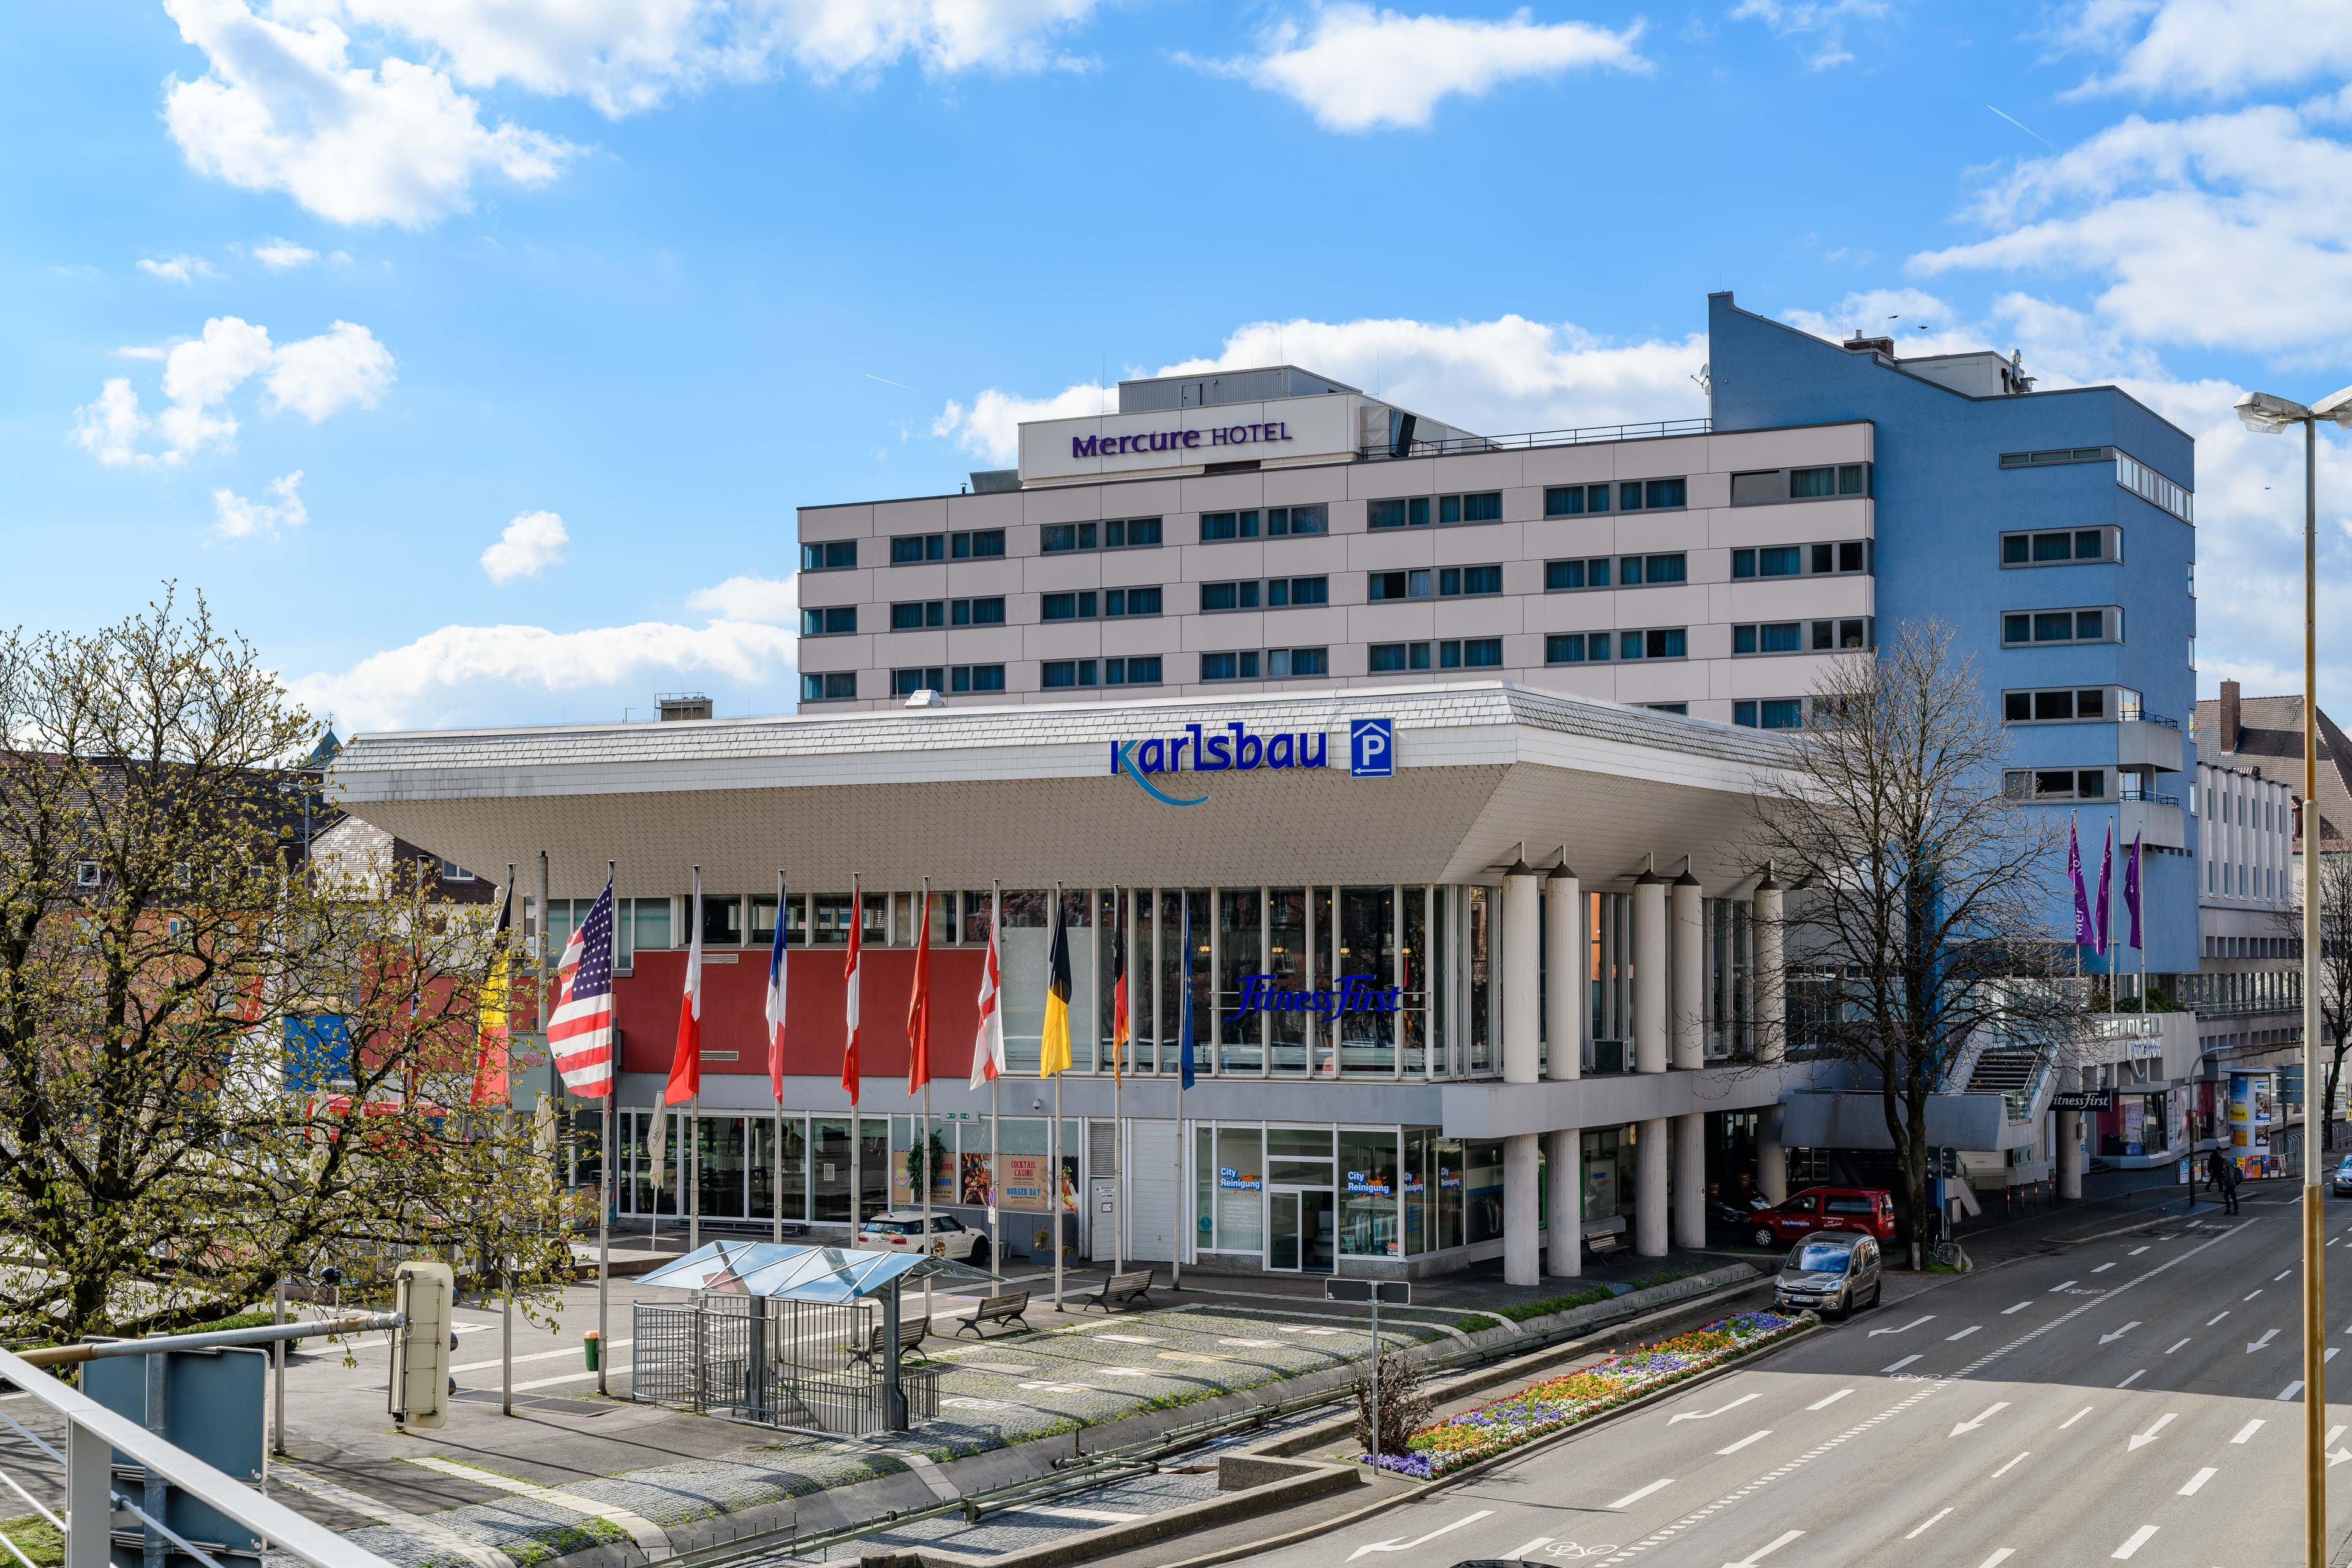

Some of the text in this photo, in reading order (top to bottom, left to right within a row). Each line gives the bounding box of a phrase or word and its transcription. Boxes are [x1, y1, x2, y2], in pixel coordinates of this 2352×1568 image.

[1072, 422, 1293, 458] Mercure HOTEL
[1363, 734, 1385, 766] P
[1110, 722, 1328, 806] Karlsbau
[1220, 1167, 1237, 1177] City
[1348, 1170, 1365, 1182] City
[1441, 1167, 1450, 1176] City
[1404, 1172, 1413, 1182] City
[1220, 1178, 1261, 1189] Reinigung
[1441, 1178, 1460, 1187] Reinigung
[1006, 1187, 1028, 1196] BURGER
[1348, 1182, 1390, 1194] Reinigung
[1404, 1183, 1424, 1193] Reinigung
